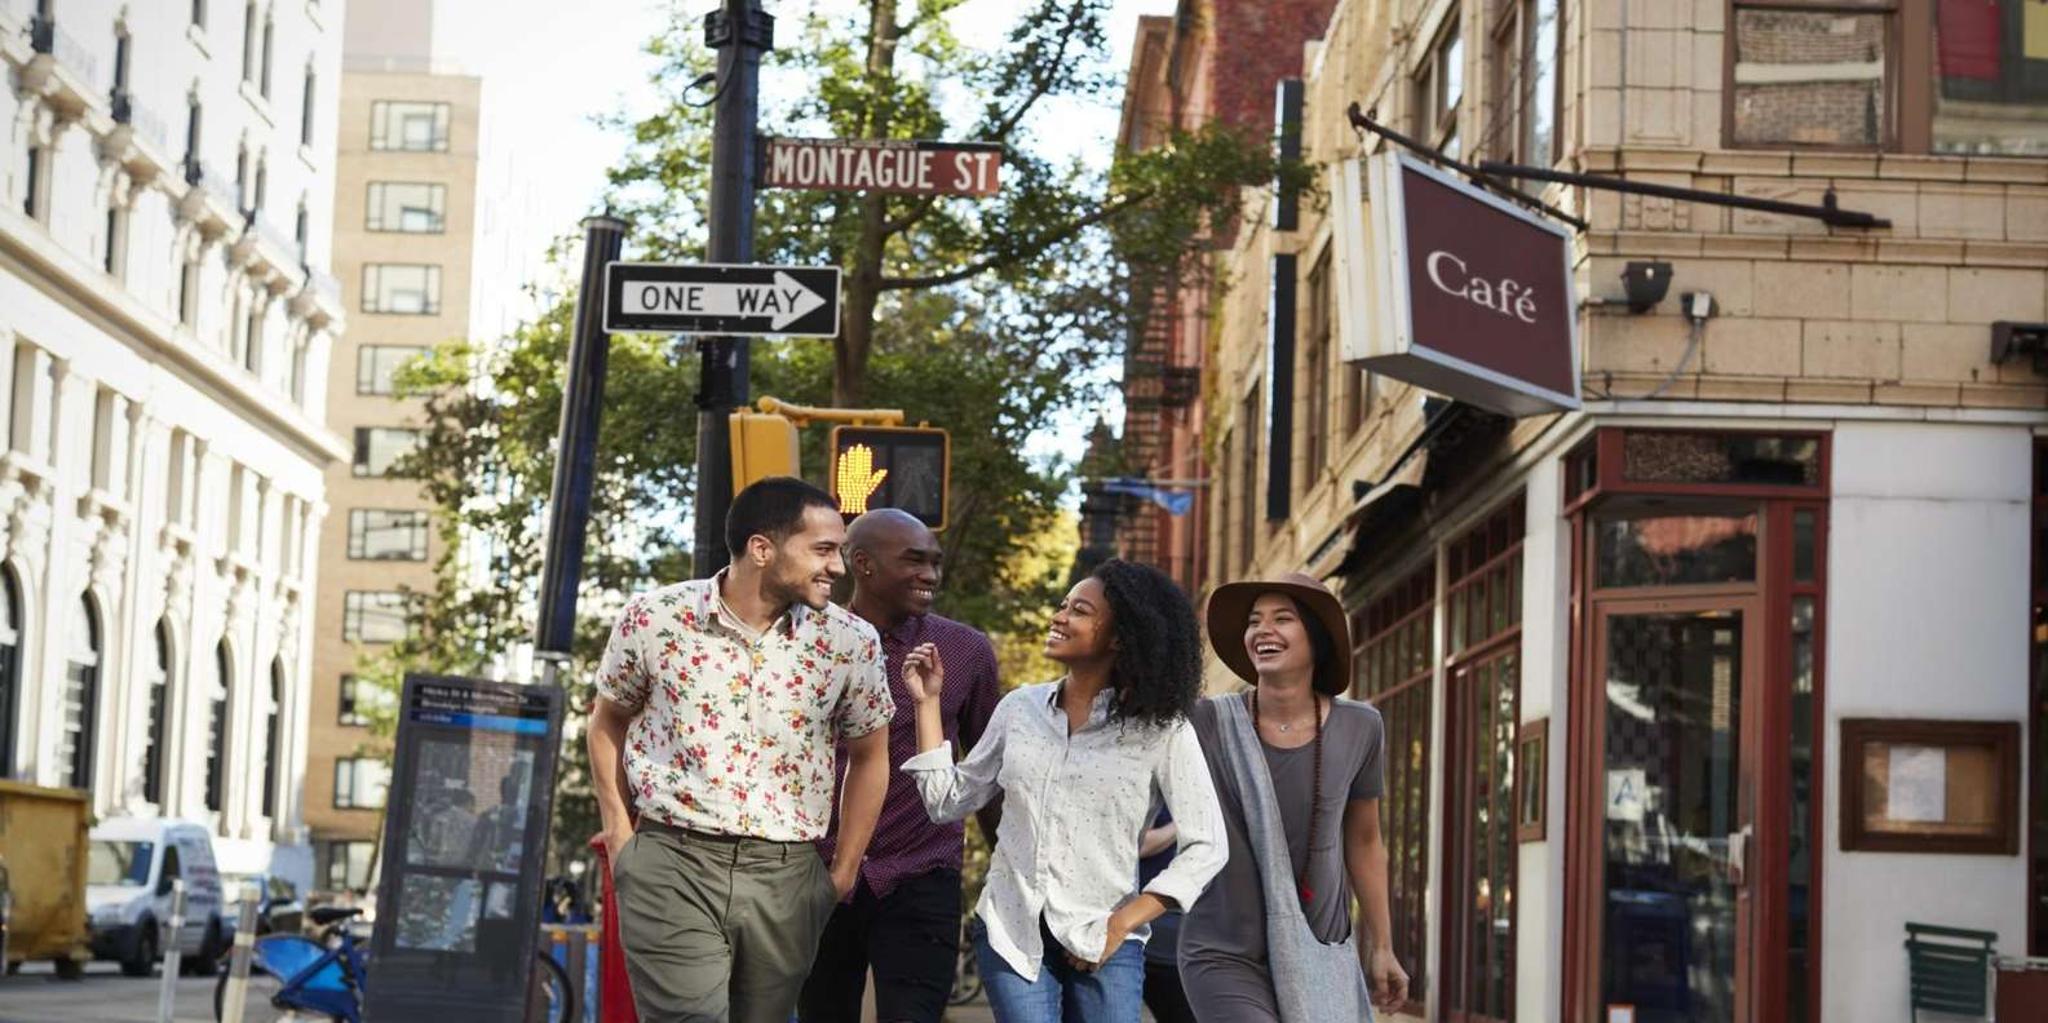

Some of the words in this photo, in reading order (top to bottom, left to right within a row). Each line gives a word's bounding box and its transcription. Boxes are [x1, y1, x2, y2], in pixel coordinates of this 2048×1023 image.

[772, 146, 935, 189] MONTAGUE
[953, 152, 992, 191] ST
[641, 286, 704, 311] ONE
[737, 288, 803, 314] WAY
[1427, 250, 1537, 323] Café
[1614, 777, 1637, 805] A
